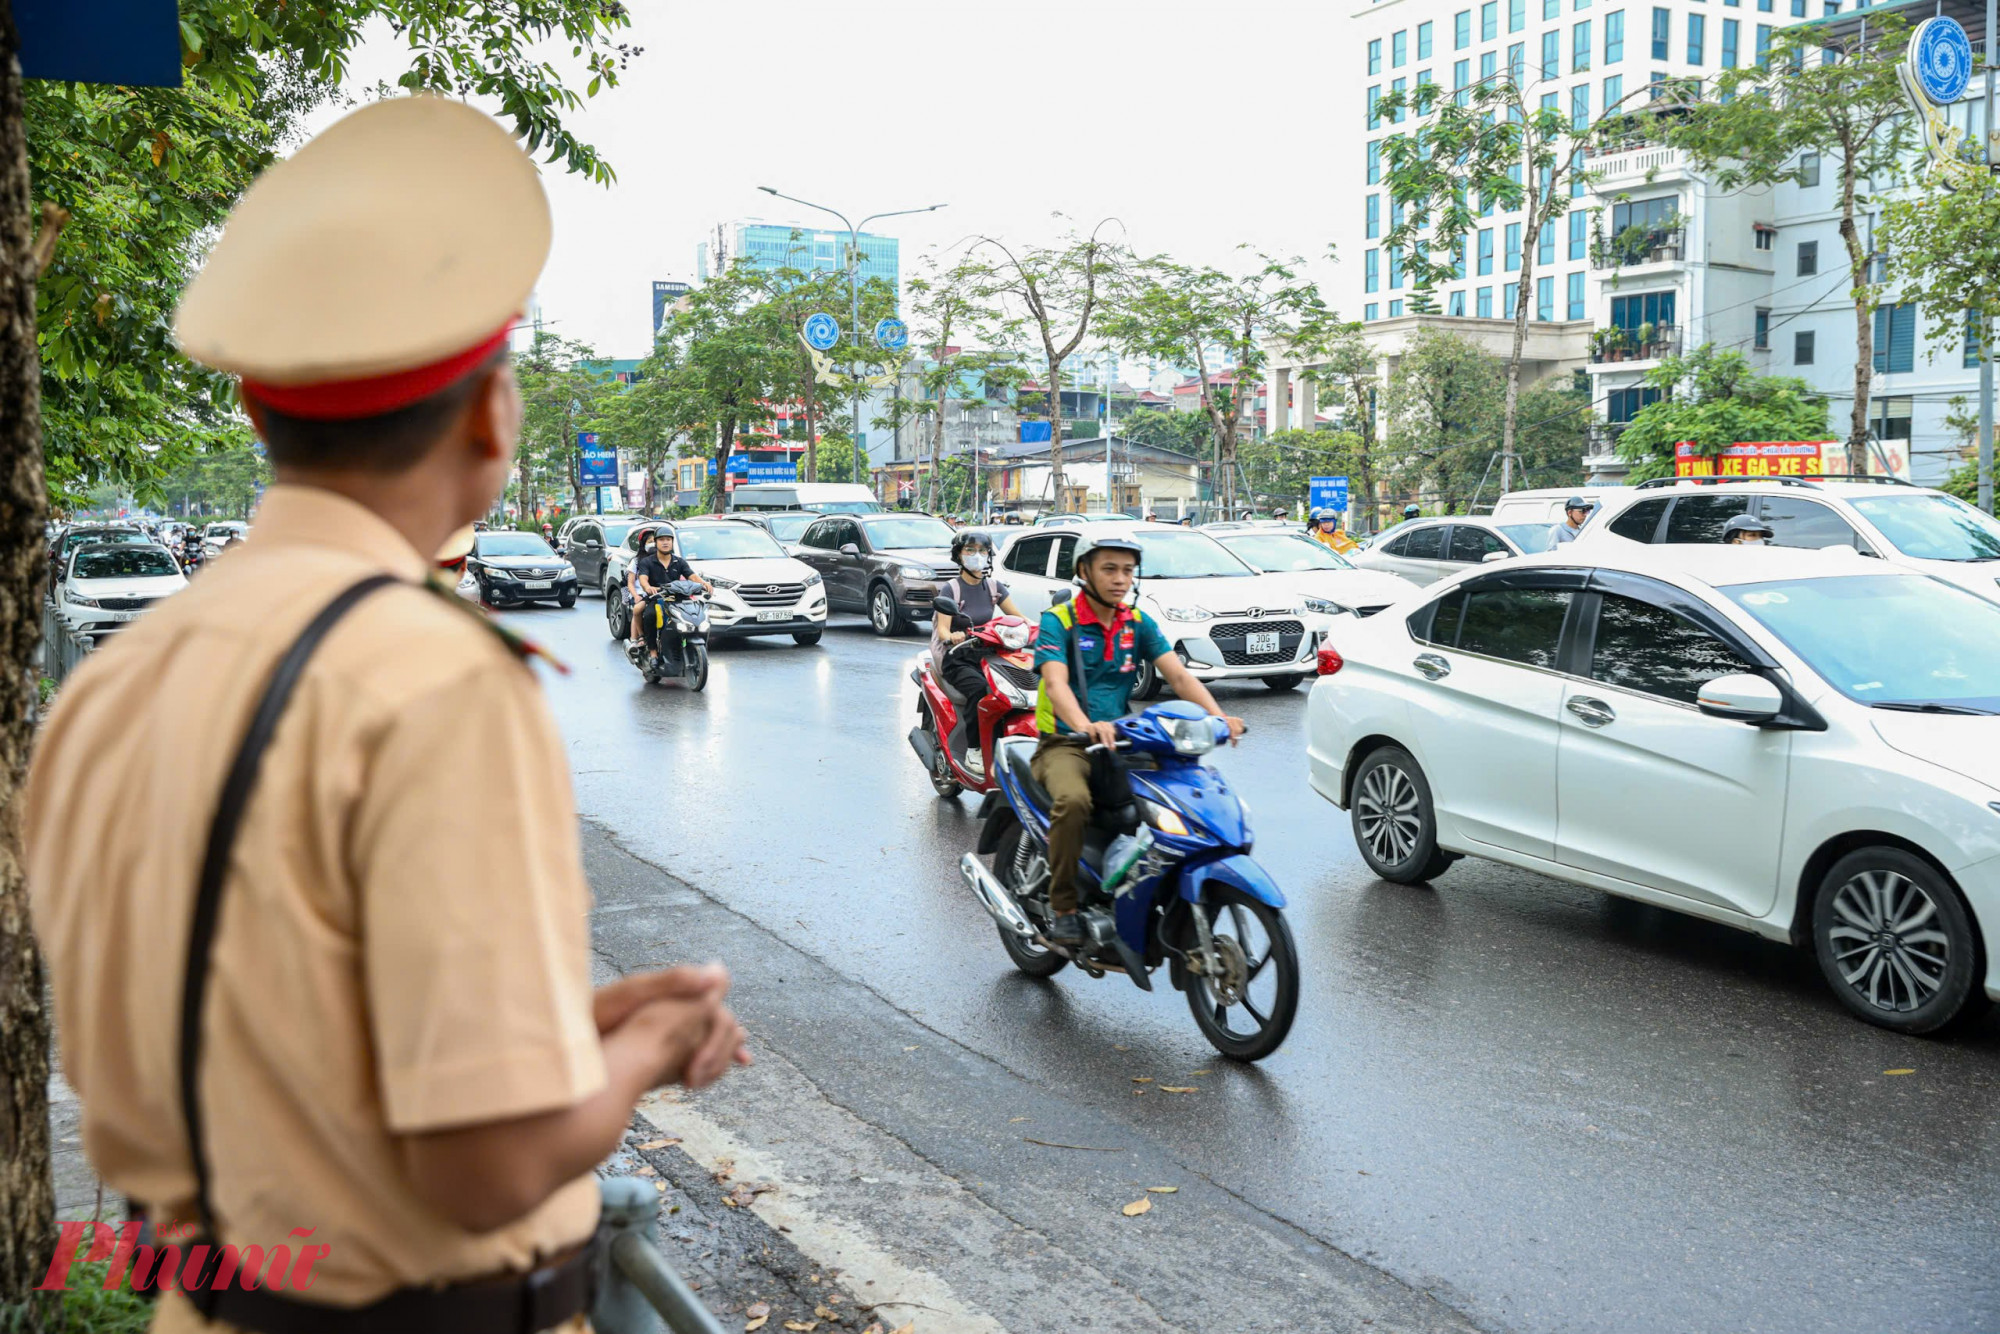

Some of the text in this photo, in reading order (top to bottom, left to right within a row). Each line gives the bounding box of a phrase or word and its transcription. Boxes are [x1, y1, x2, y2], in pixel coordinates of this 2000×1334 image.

[655, 283, 689, 291] SAMSUNG
[1722, 458, 1743, 476] XE
[1256, 633, 1270, 643] 30G
[1250, 643, 1276, 653] 644.57
